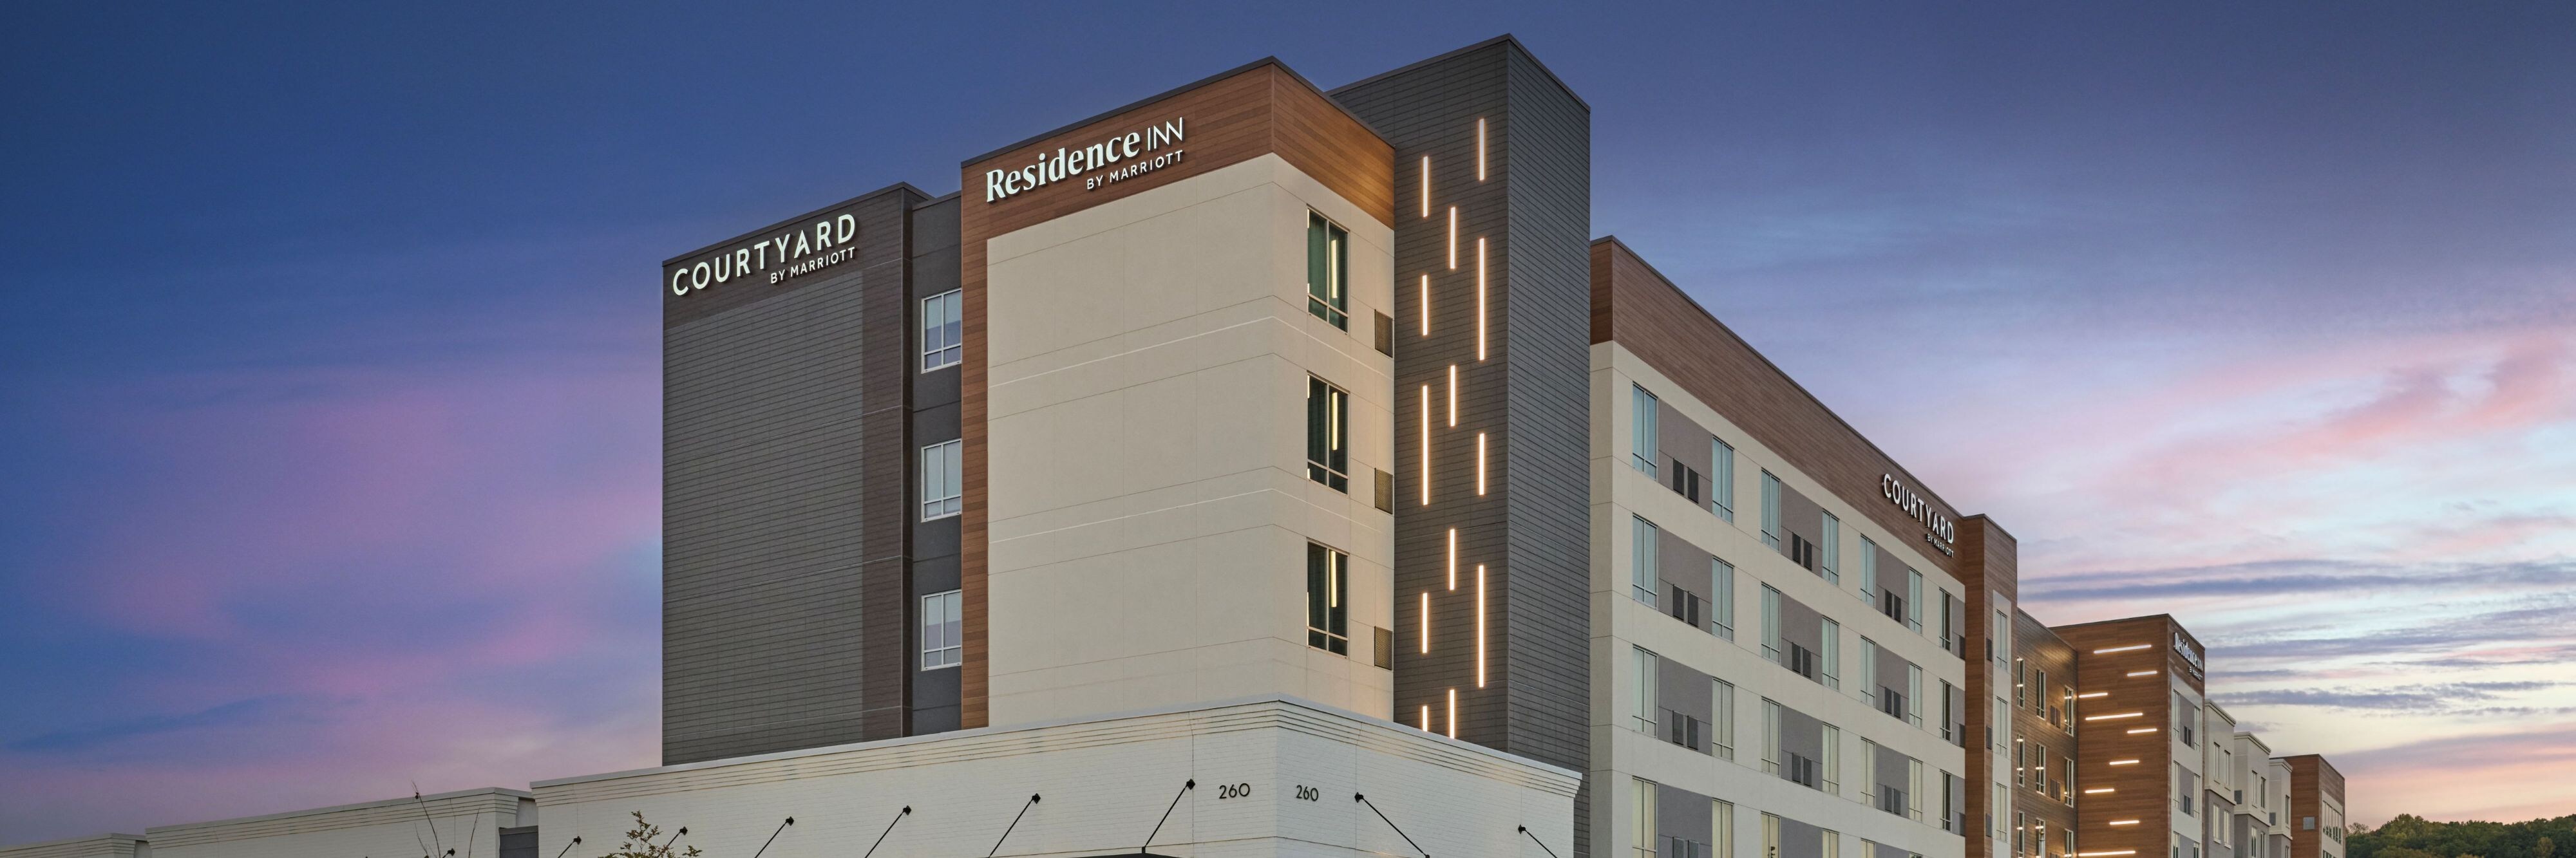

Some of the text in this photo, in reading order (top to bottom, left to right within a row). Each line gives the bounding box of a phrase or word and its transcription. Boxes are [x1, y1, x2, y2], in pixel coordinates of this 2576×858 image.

[986, 117, 1184, 203] Residence INN
[1087, 149, 1183, 191] BY MARRIOTT
[672, 214, 856, 296] COURTYARD
[771, 247, 855, 284] BY MARRIOTT
[1884, 473, 1954, 544] COURTYARD
[1934, 538, 1954, 557] MARRIOTT
[1219, 783, 1250, 799] 260
[1296, 785, 1319, 801] 260
